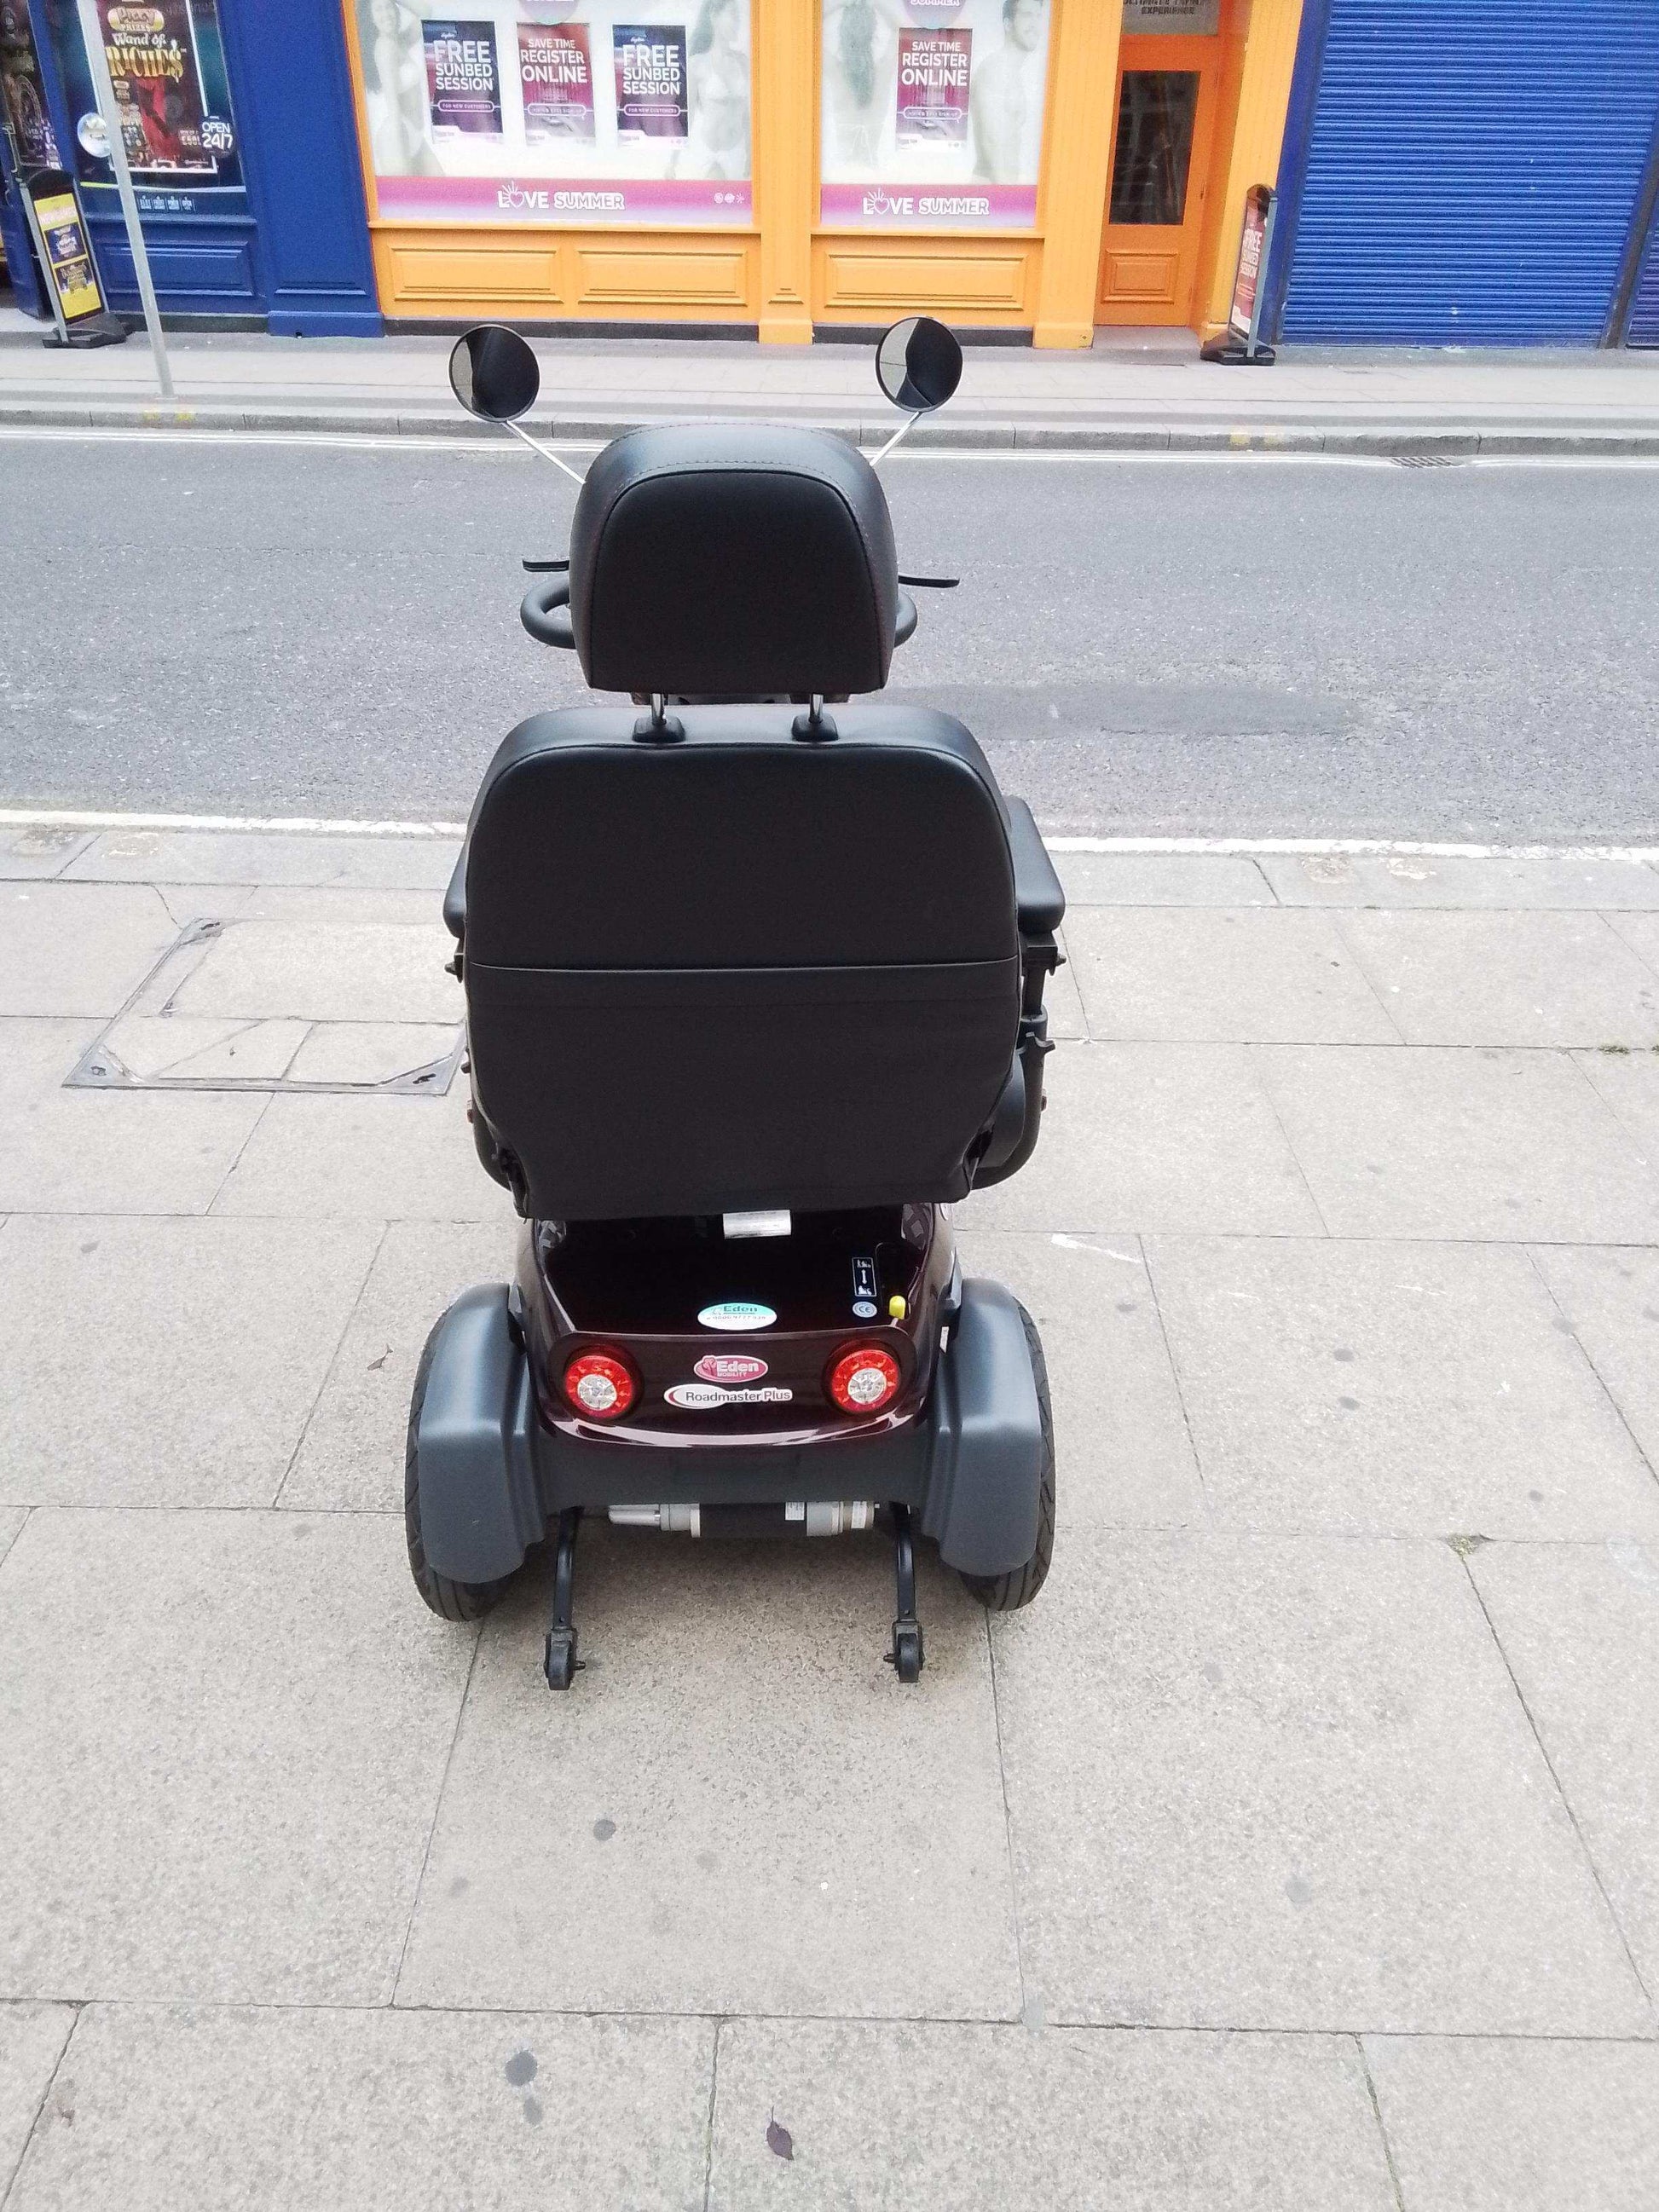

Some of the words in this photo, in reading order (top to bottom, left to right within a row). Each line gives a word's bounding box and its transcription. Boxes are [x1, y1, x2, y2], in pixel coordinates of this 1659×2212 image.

[112, 33, 149, 46] Wand
[529, 38, 552, 49] SAVE
[553, 39, 576, 49] TIME
[911, 41, 937, 51] SAVE
[938, 42, 962, 52] TIME
[433, 40, 492, 63] FREE
[520, 49, 585, 64] REGISTER
[622, 44, 679, 67] FREE
[902, 53, 967, 66] REGISTER
[436, 63, 492, 78] SUNBED
[522, 65, 587, 84] ONLINE
[623, 67, 680, 81] SUNBED
[901, 69, 968, 86] ONLINE
[202, 121, 231, 133] OPEN
[202, 132, 234, 150] 24/7
[497, 190, 550, 210] LOVE
[554, 191, 626, 211] SUMMER
[863, 197, 914, 216] LOVE
[919, 197, 990, 216] SUMMER
[716, 1360, 760, 1372] Eden
[685, 1391, 760, 1401] Roadmaster
[764, 1390, 790, 1401] Plus
